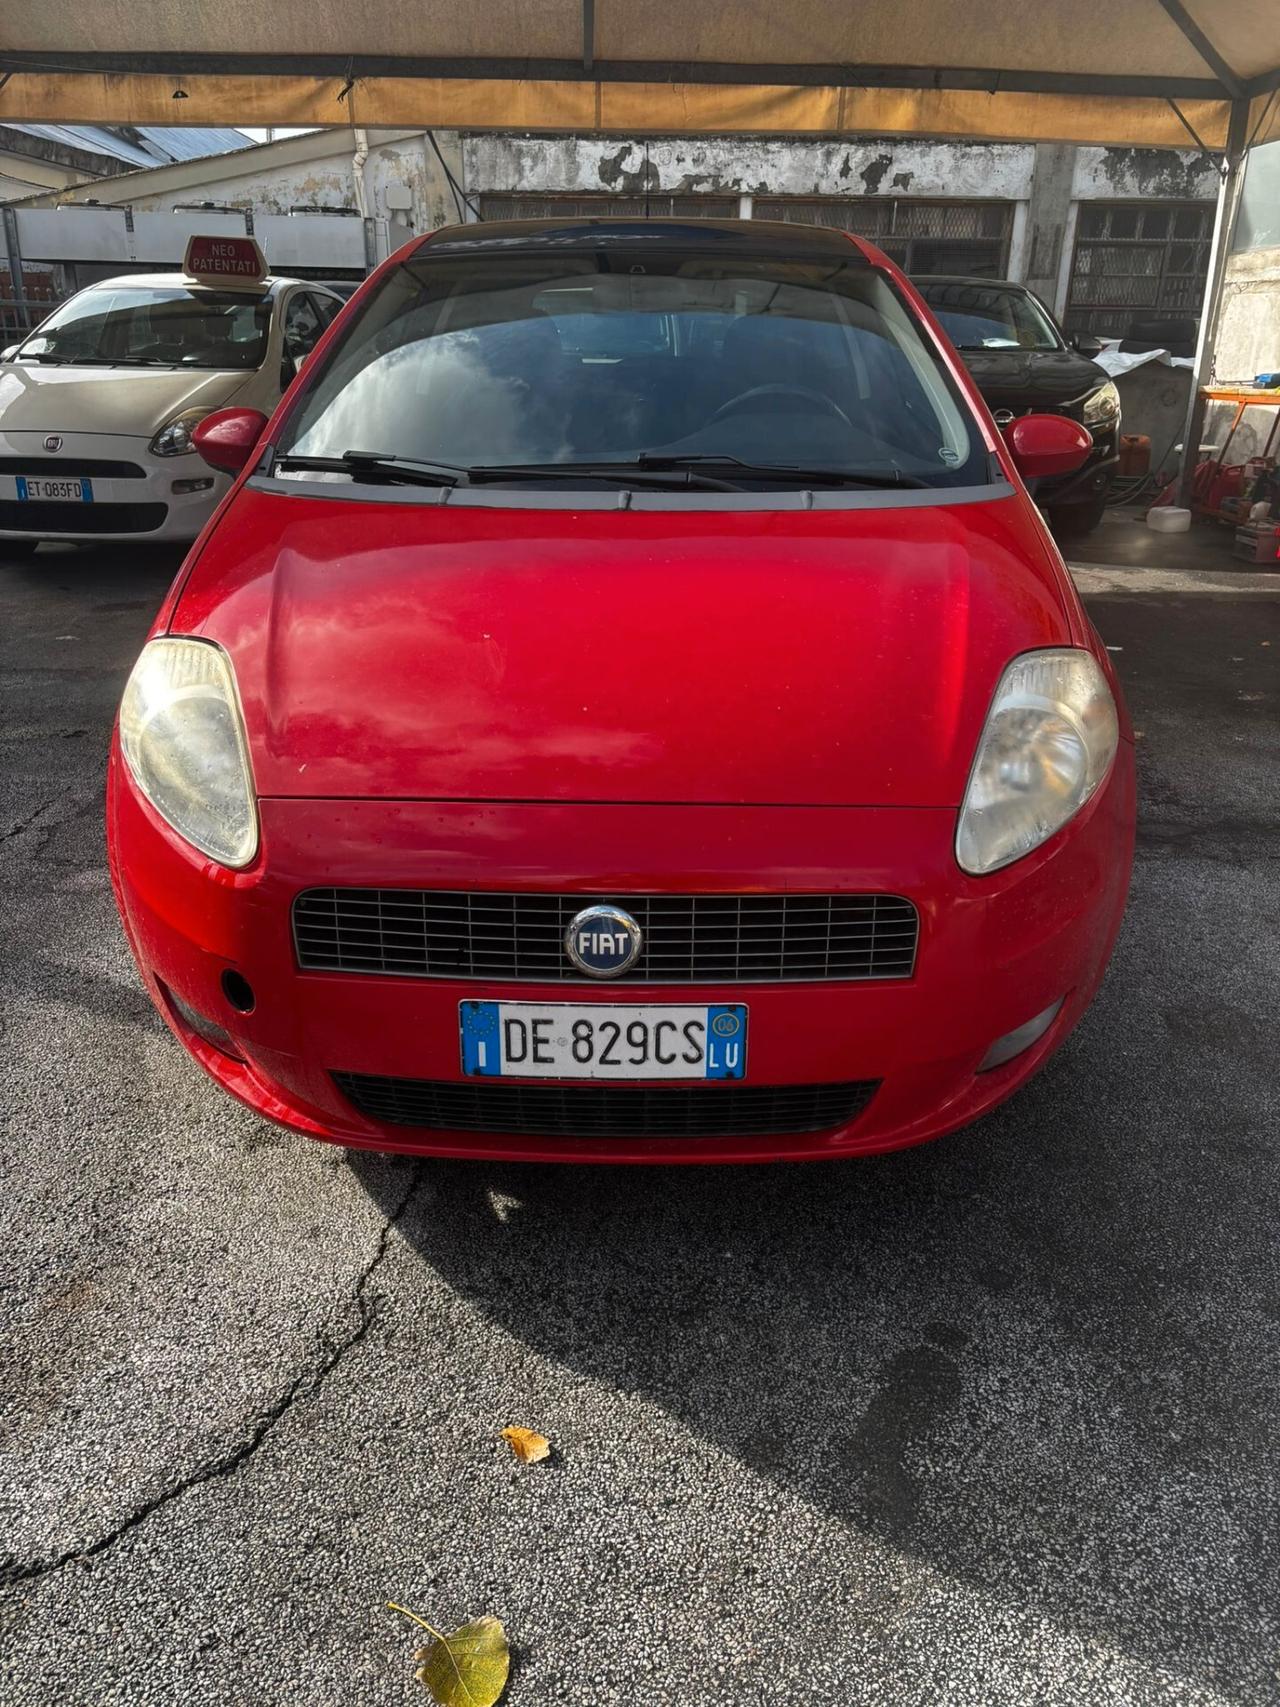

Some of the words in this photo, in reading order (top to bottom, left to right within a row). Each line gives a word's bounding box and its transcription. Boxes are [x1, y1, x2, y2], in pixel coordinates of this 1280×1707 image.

[211, 244, 236, 257] NEO
[193, 257, 256, 273] PATENTATI
[27, 481, 41, 497] ET
[44, 482, 82, 498] 083FD
[579, 932, 629, 955] FIAT
[504, 1018, 555, 1064] DE
[571, 1019, 706, 1066] 829CS
[709, 1042, 739, 1068] LU
